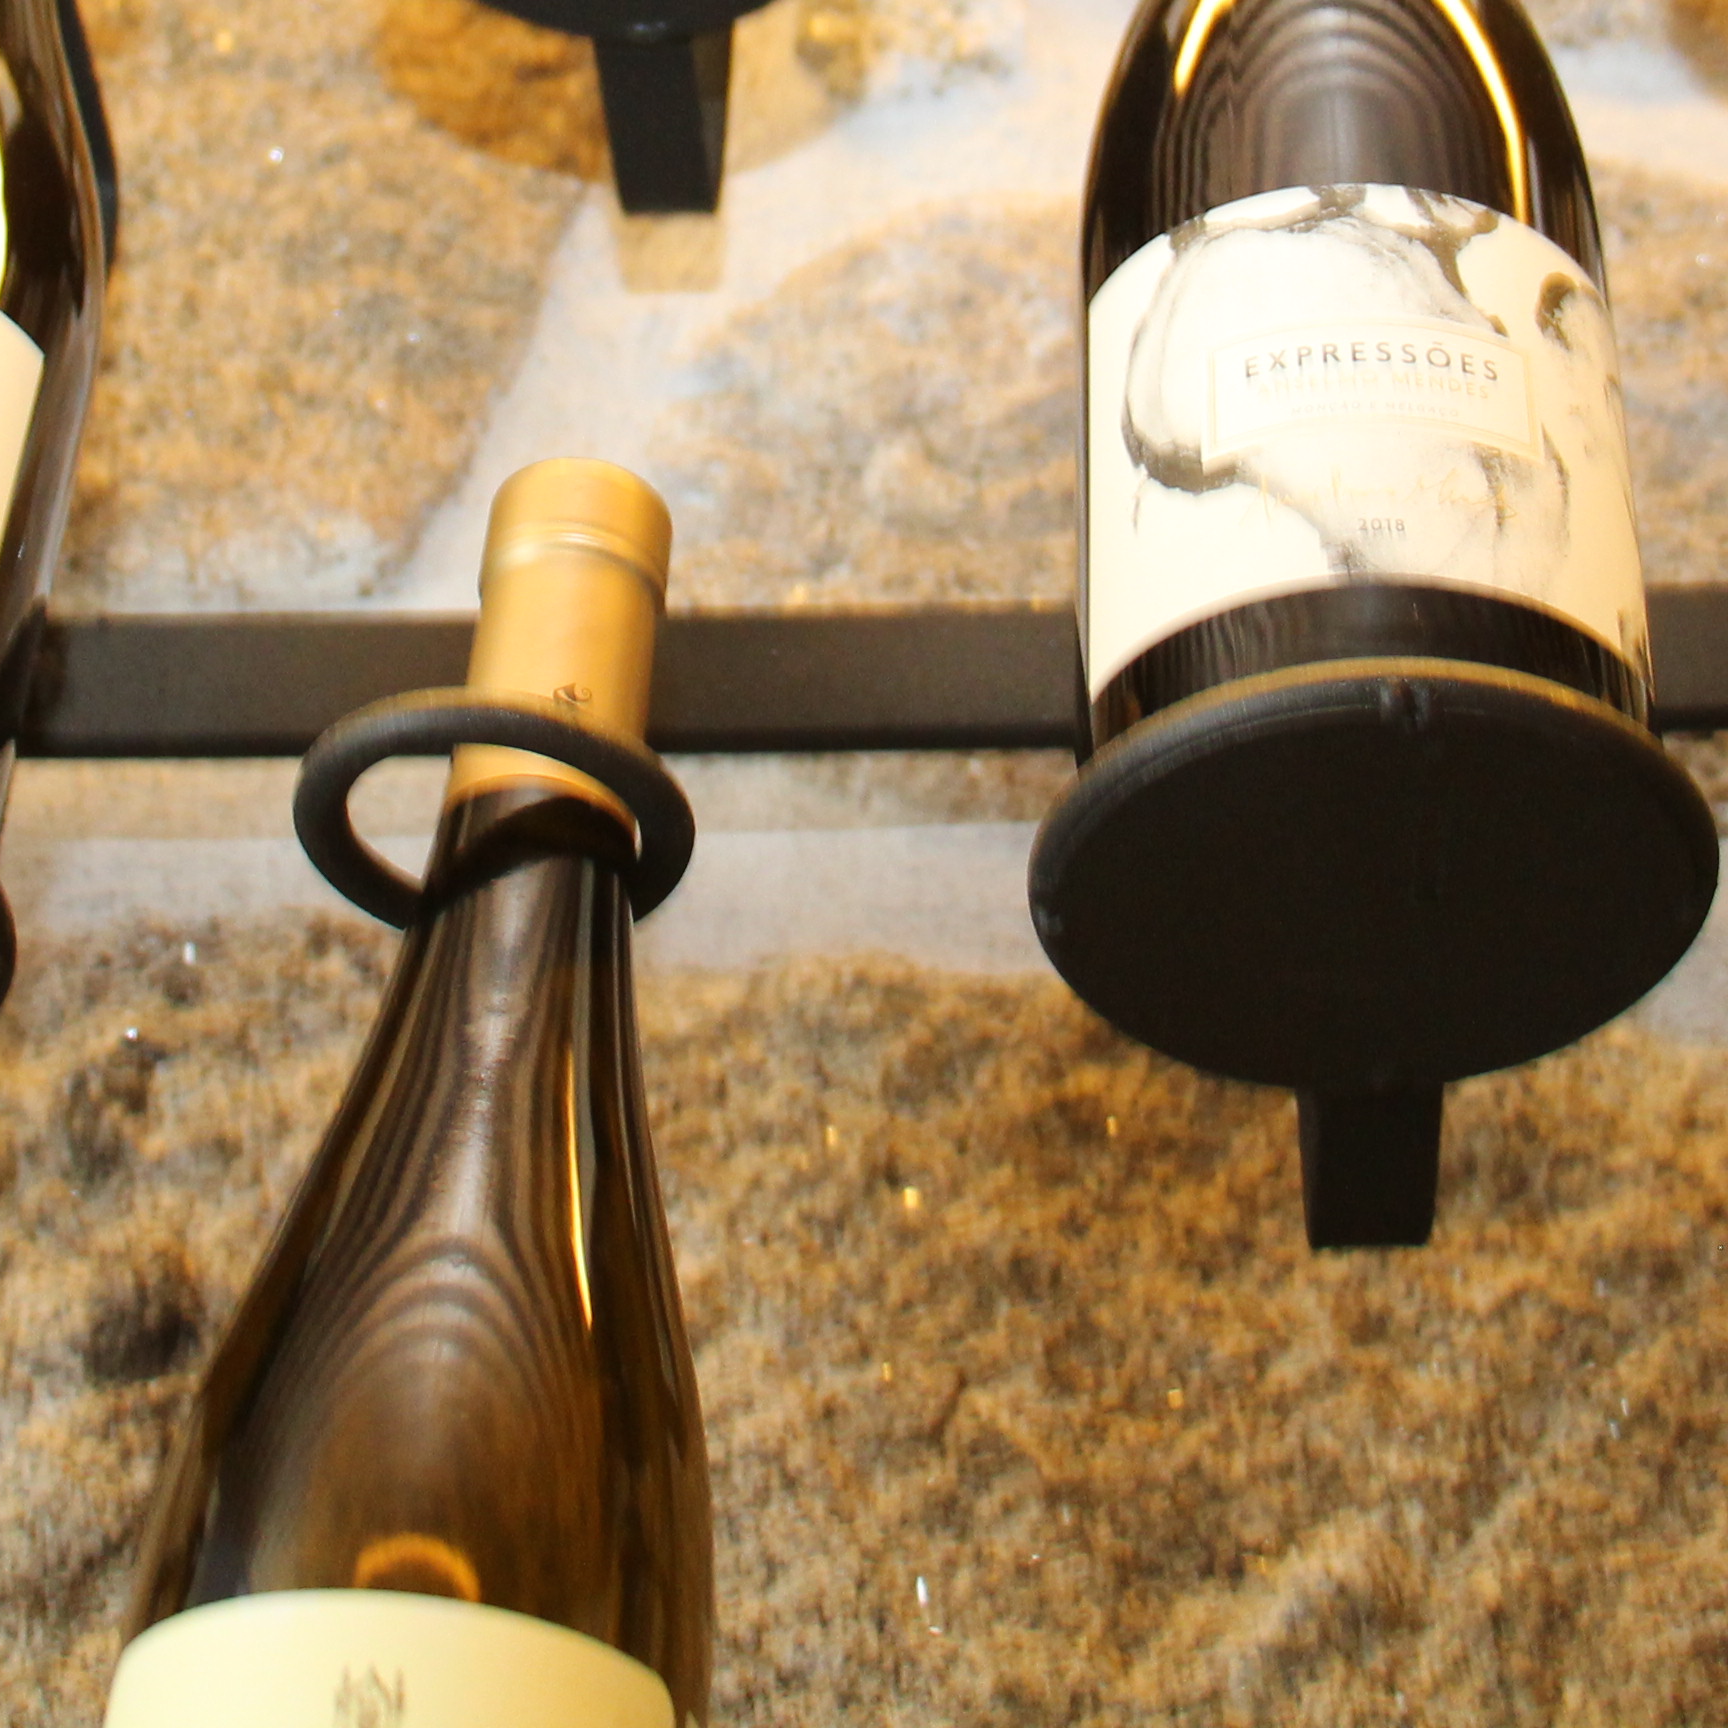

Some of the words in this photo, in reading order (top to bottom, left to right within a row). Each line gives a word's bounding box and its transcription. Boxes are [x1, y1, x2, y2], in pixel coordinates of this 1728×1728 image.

[1243, 339, 1500, 383] EXPRESSÕES
[1391, 369, 1491, 400] MENDES
[1356, 517, 1406, 534] 2018
